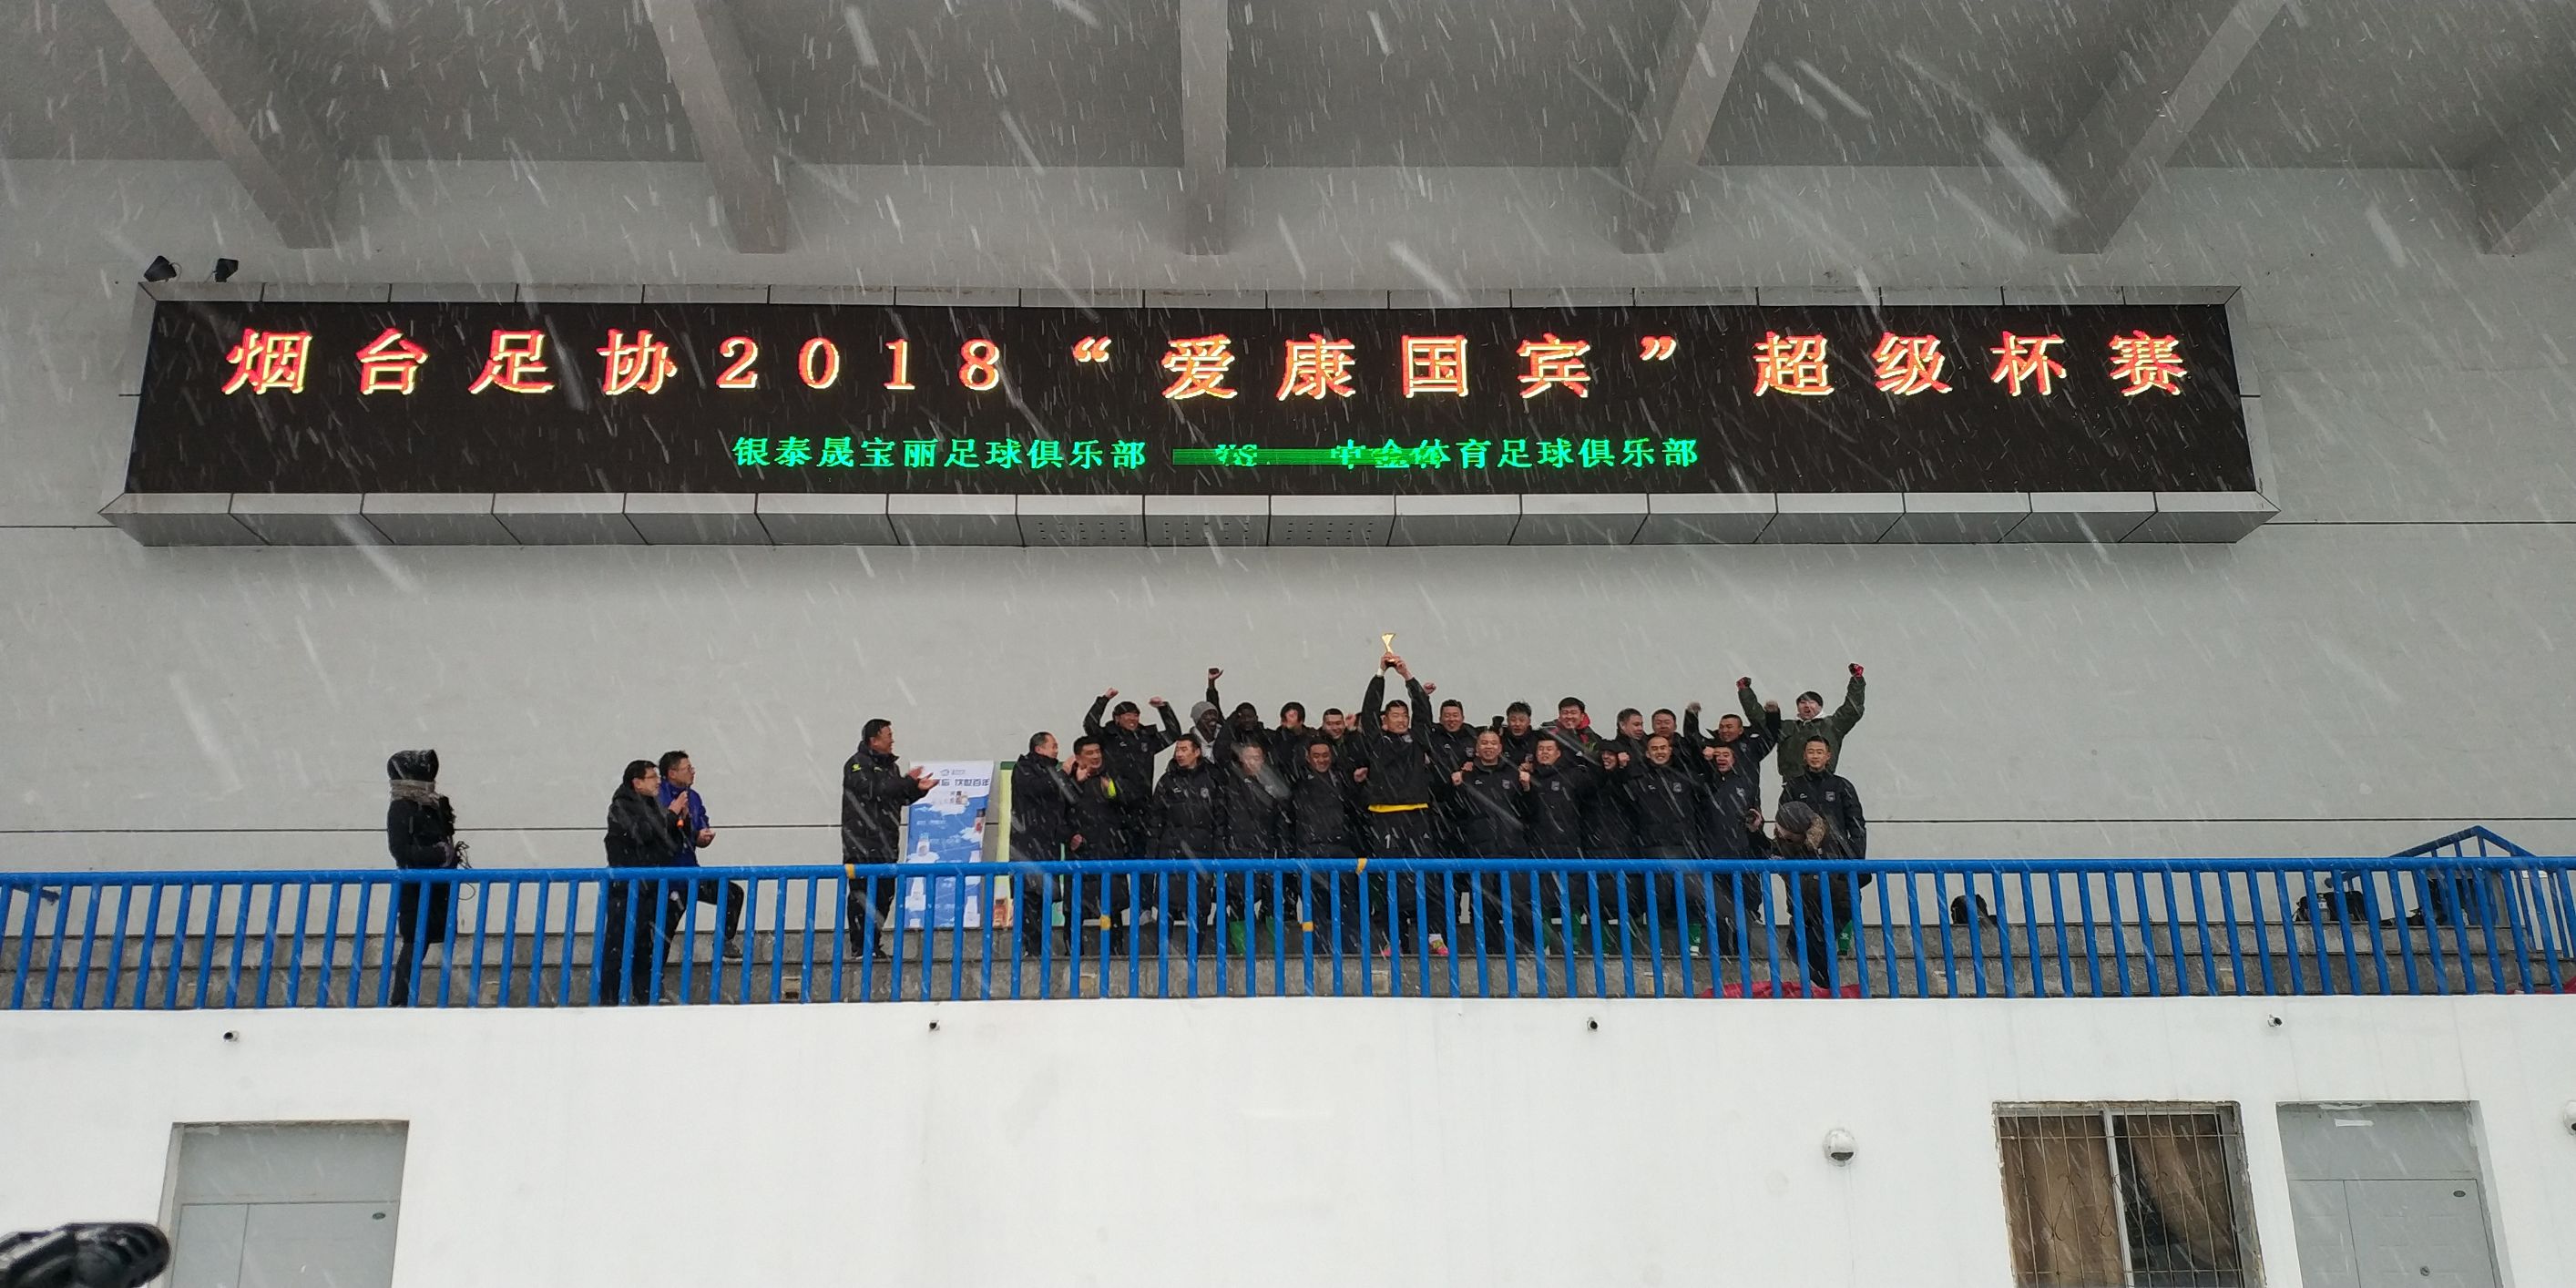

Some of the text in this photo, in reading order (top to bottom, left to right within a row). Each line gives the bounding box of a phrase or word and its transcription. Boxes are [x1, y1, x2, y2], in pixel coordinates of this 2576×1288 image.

[221, 328, 2184, 398] 烟台足协2018“爱康国宾”超级杯赛
[731, 435, 1146, 470] 银泰晟宝丽足球俱乐部
